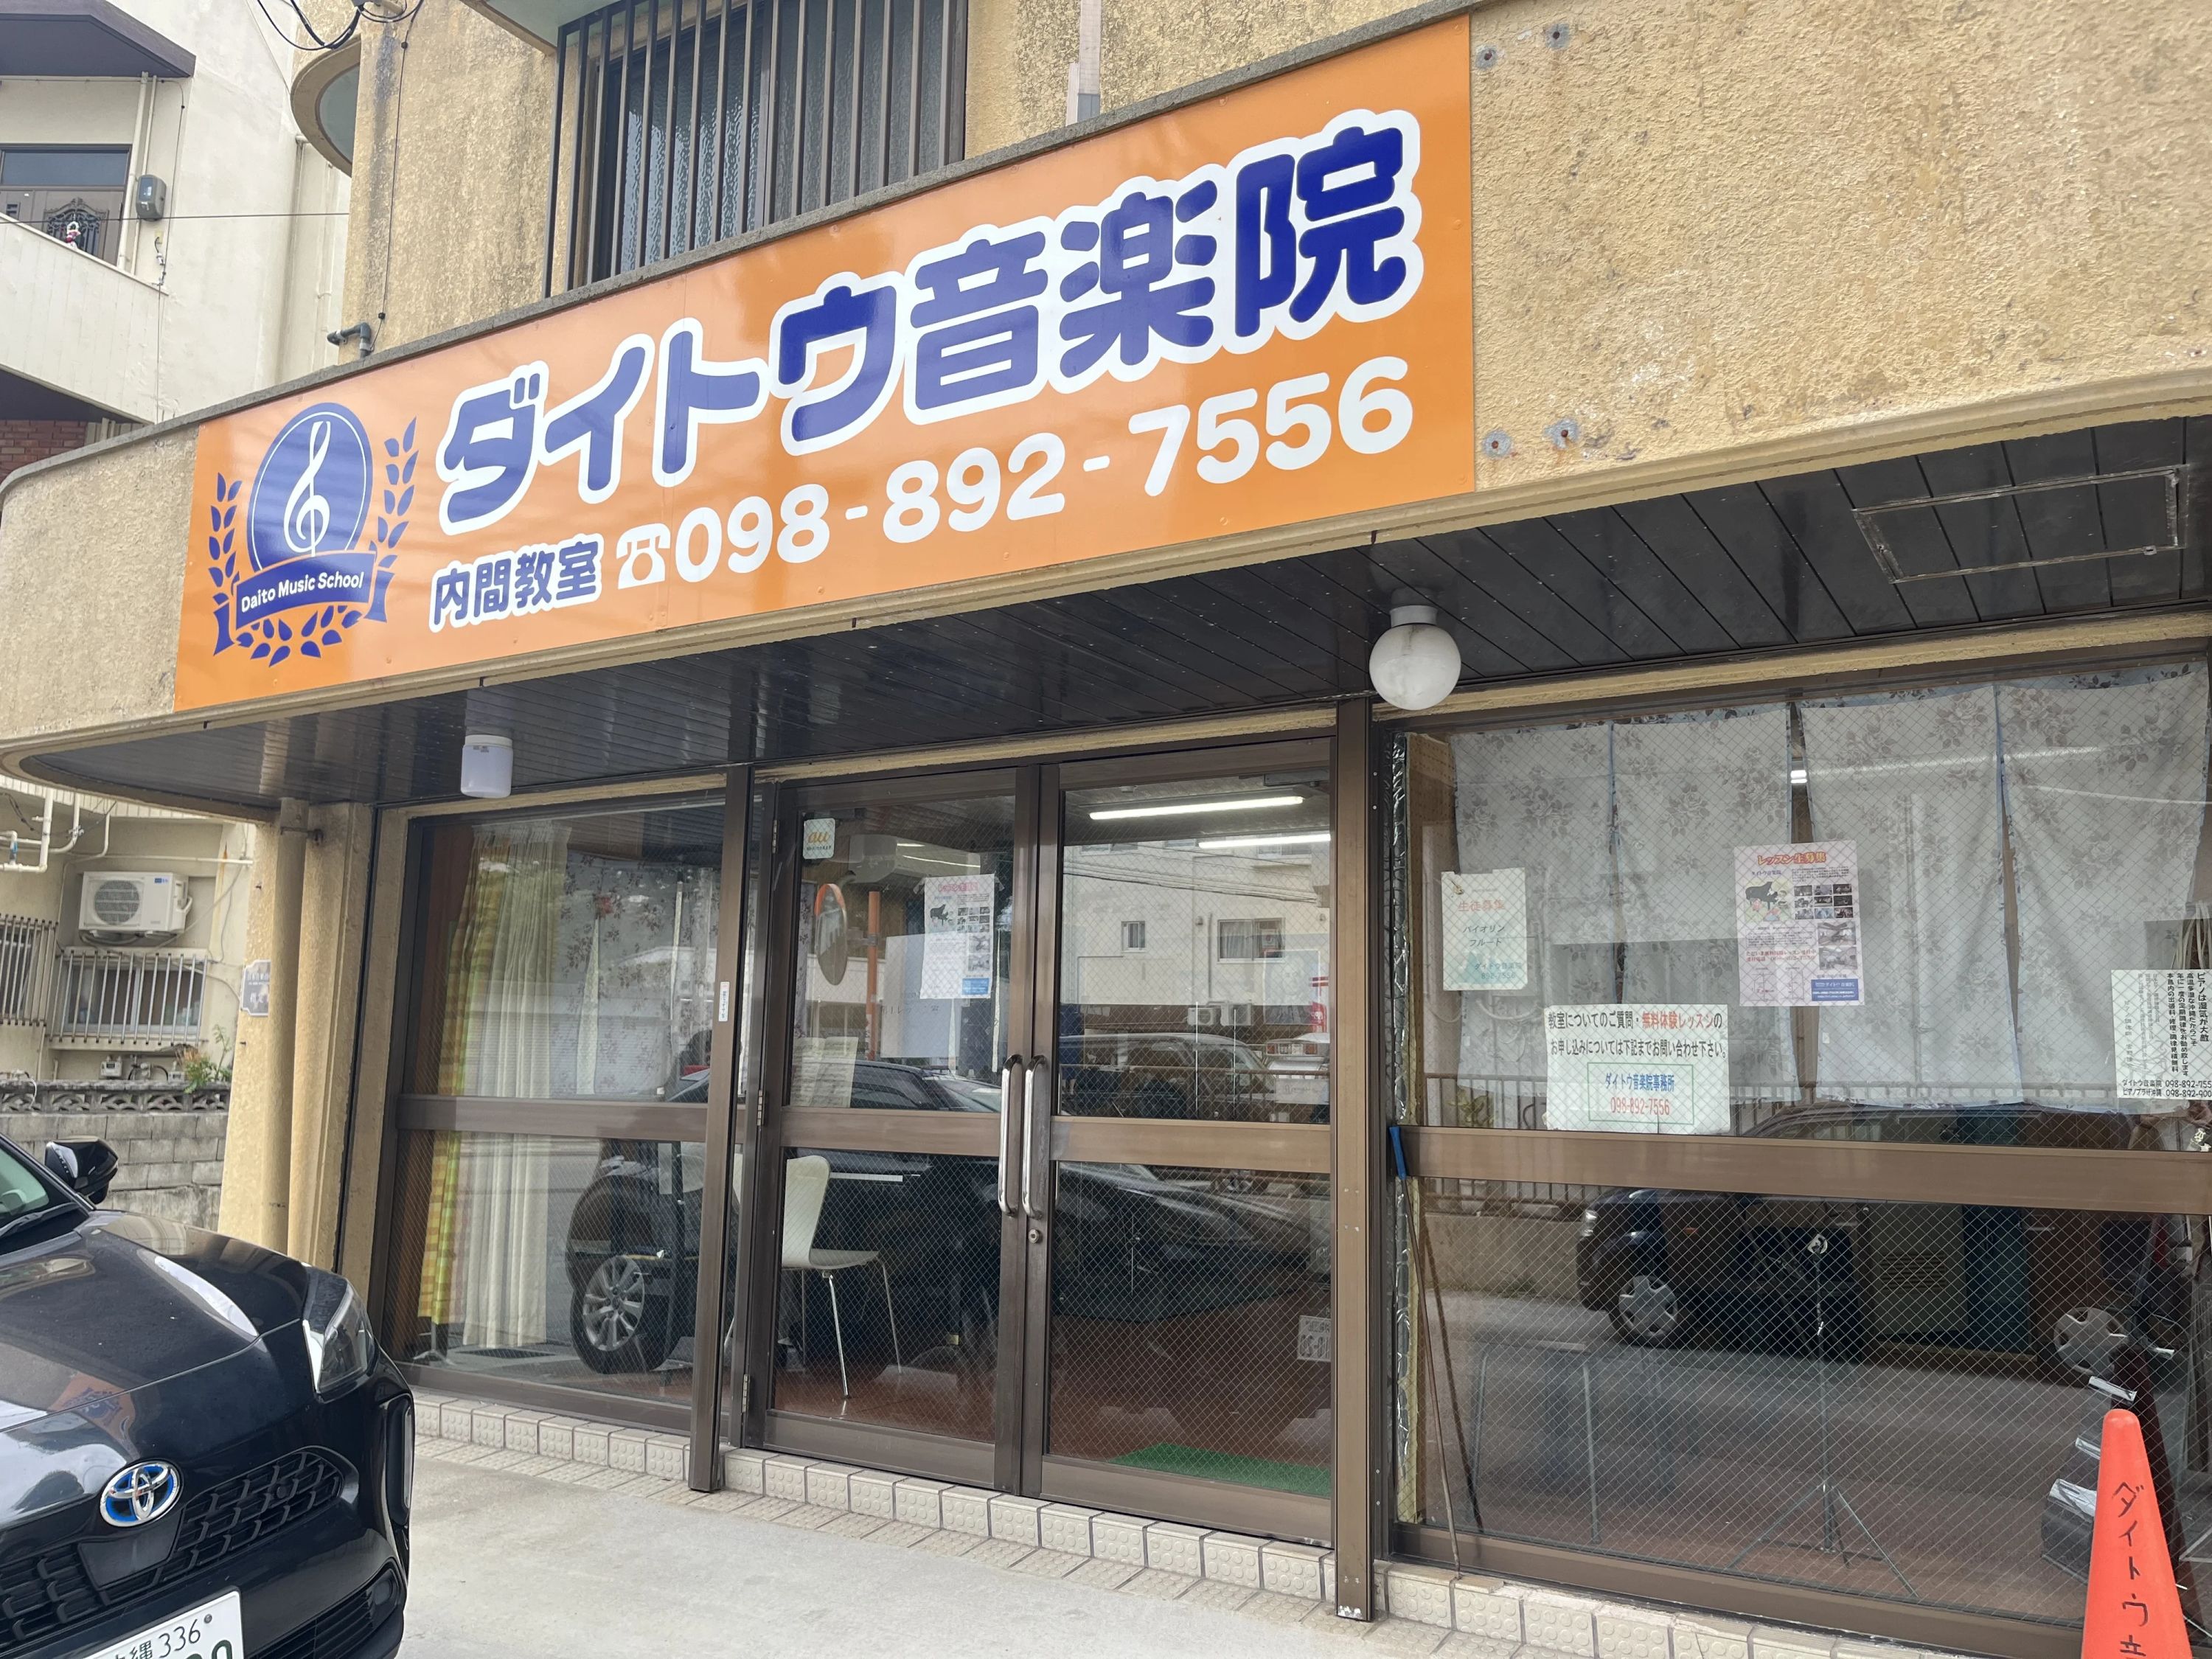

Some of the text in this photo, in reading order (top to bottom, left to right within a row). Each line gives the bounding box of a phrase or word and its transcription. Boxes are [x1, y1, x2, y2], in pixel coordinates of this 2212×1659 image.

[439, 118, 1417, 532] ダイトウ音楽院
[675, 356, 1415, 583] 098-892-7556
[240, 571, 364, 613] Daito Music School
[432, 537, 601, 630] 内間教室
[1458, 898, 1506, 912] 生徒募集
[1462, 925, 1505, 933] バイオリン
[1470, 938, 1502, 947] フルート
[2197, 973, 2210, 1042] ピアノは湿気が大敵
[1548, 1010, 1722, 1030] 教室についてのご質問・無料体験レッスンの
[1550, 1038, 1727, 1059] お申し込みについては下記までお問い合わせ下さい。
[1605, 1073, 1675, 1092] ダイトウ音楽院事務所
[2122, 1079, 2163, 1088] ダイトウ音楽院
[1610, 1096, 1670, 1116] 098-892-7556
[159, 1618, 201, 1658] 336
